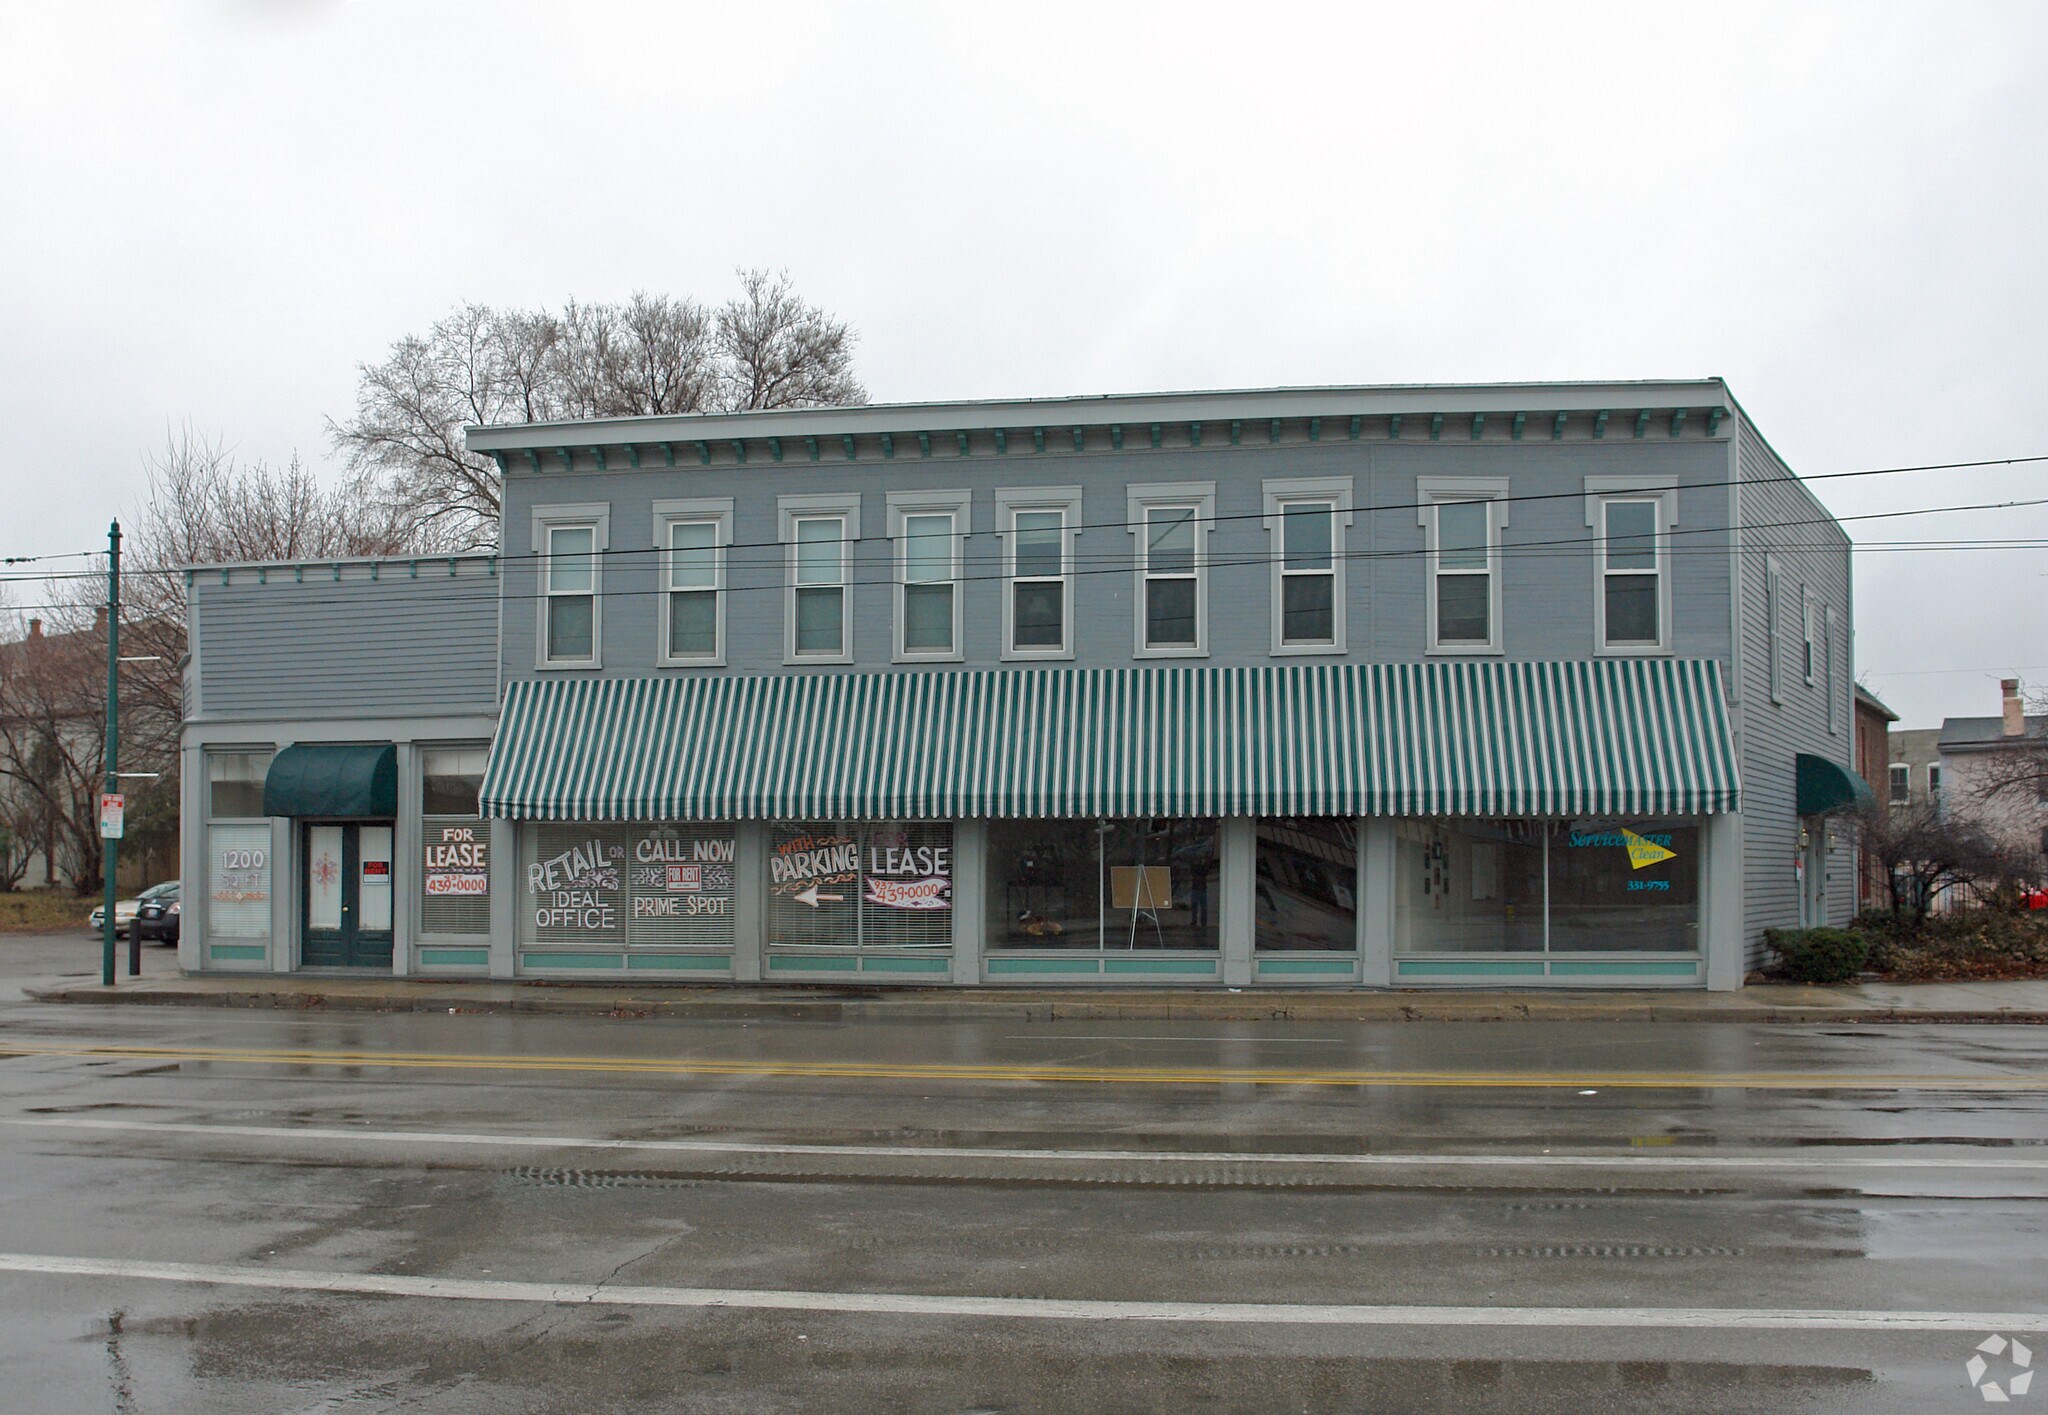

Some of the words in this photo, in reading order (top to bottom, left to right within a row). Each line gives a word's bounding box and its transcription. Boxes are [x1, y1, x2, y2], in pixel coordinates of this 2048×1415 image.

[443, 827, 475, 842] FOR
[223, 850, 264, 869] 1200
[426, 843, 487, 868] LEASE
[636, 839, 686, 863] CALL
[693, 839, 735, 862] NOW
[1631, 847, 1665, 860] Clean
[528, 839, 612, 894] RETAIL
[608, 845, 625, 859] OR
[770, 843, 859, 884] PARKING
[871, 846, 949, 876] LEASE
[221, 874, 239, 888] SQ
[668, 867, 681, 882] FOR
[682, 867, 699, 882] RENT
[874, 880, 894, 890] 937
[1627, 881, 1670, 891] 331-9755
[552, 890, 609, 908] IDEAL
[634, 896, 680, 919] PRIME
[687, 895, 729, 915] SPOT
[536, 908, 616, 929] OFFICE
